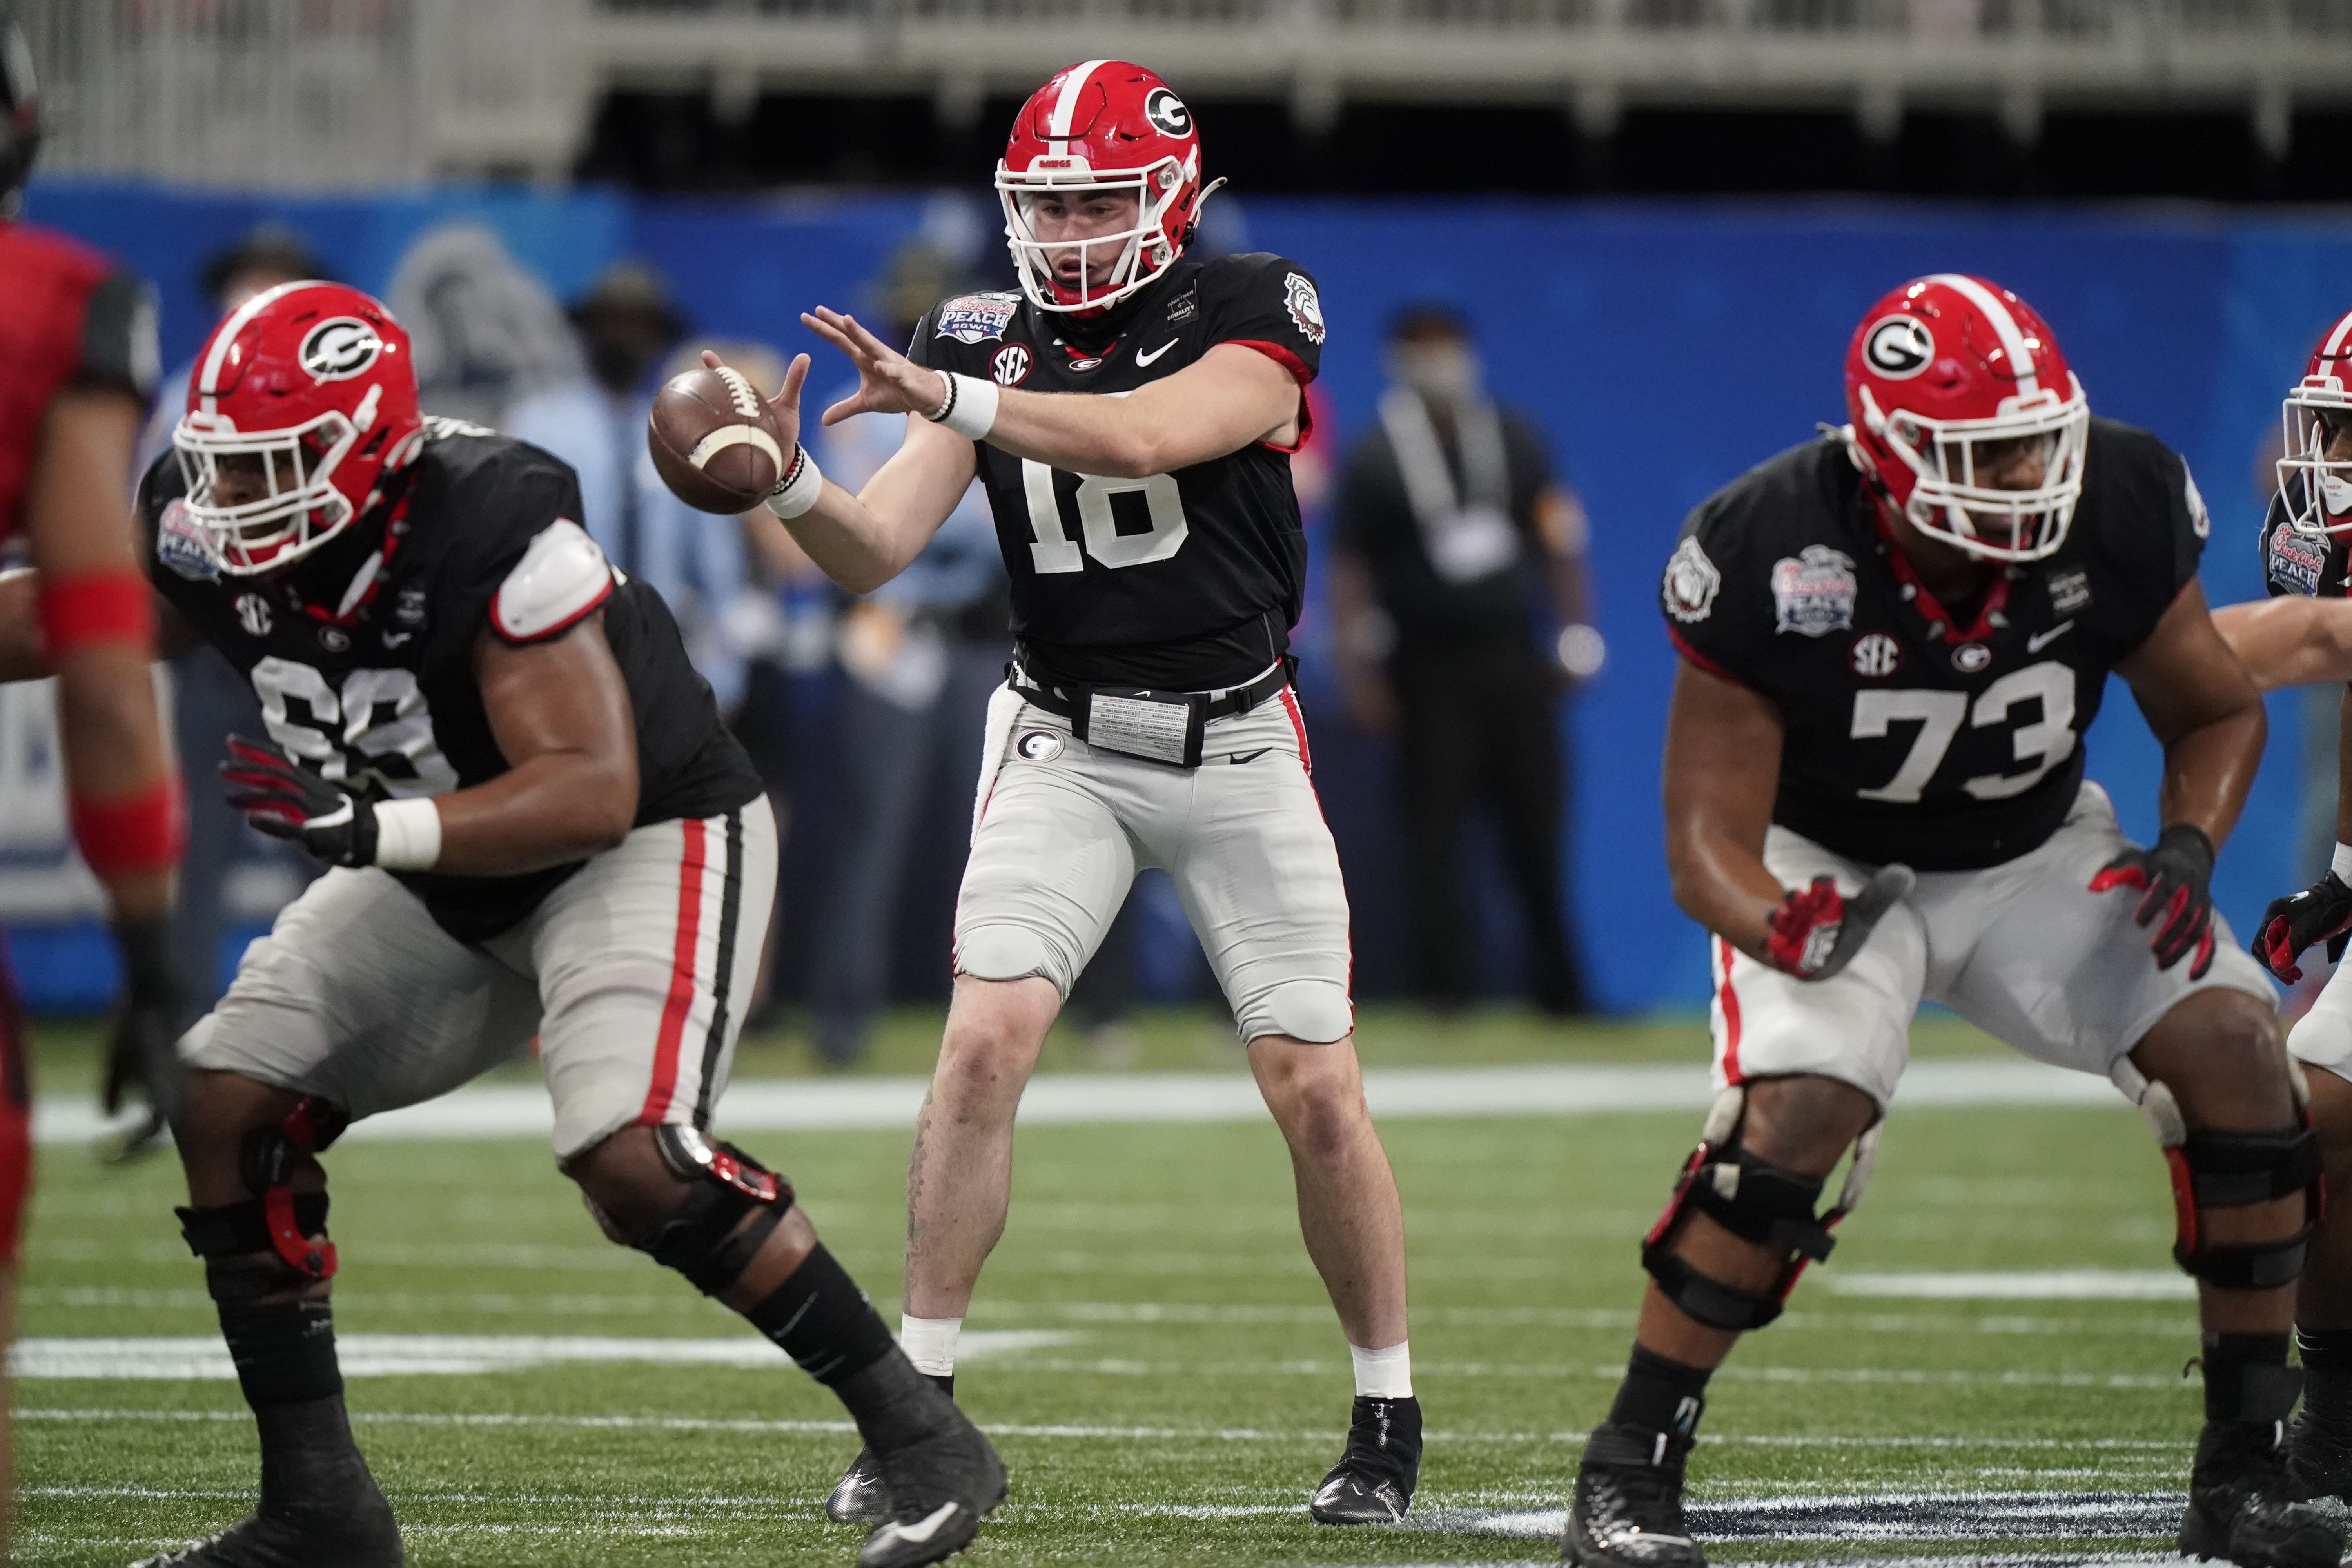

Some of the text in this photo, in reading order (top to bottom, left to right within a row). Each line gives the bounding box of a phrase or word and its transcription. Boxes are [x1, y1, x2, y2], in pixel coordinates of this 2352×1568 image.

[941, 312, 1010, 328] PEACH
[1167, 305, 1194, 321] EQUALITY
[951, 323, 990, 332] BOWL
[993, 346, 1029, 385] SEC
[2271, 554, 2318, 589] PEACH
[1849, 661, 2078, 803] 73
